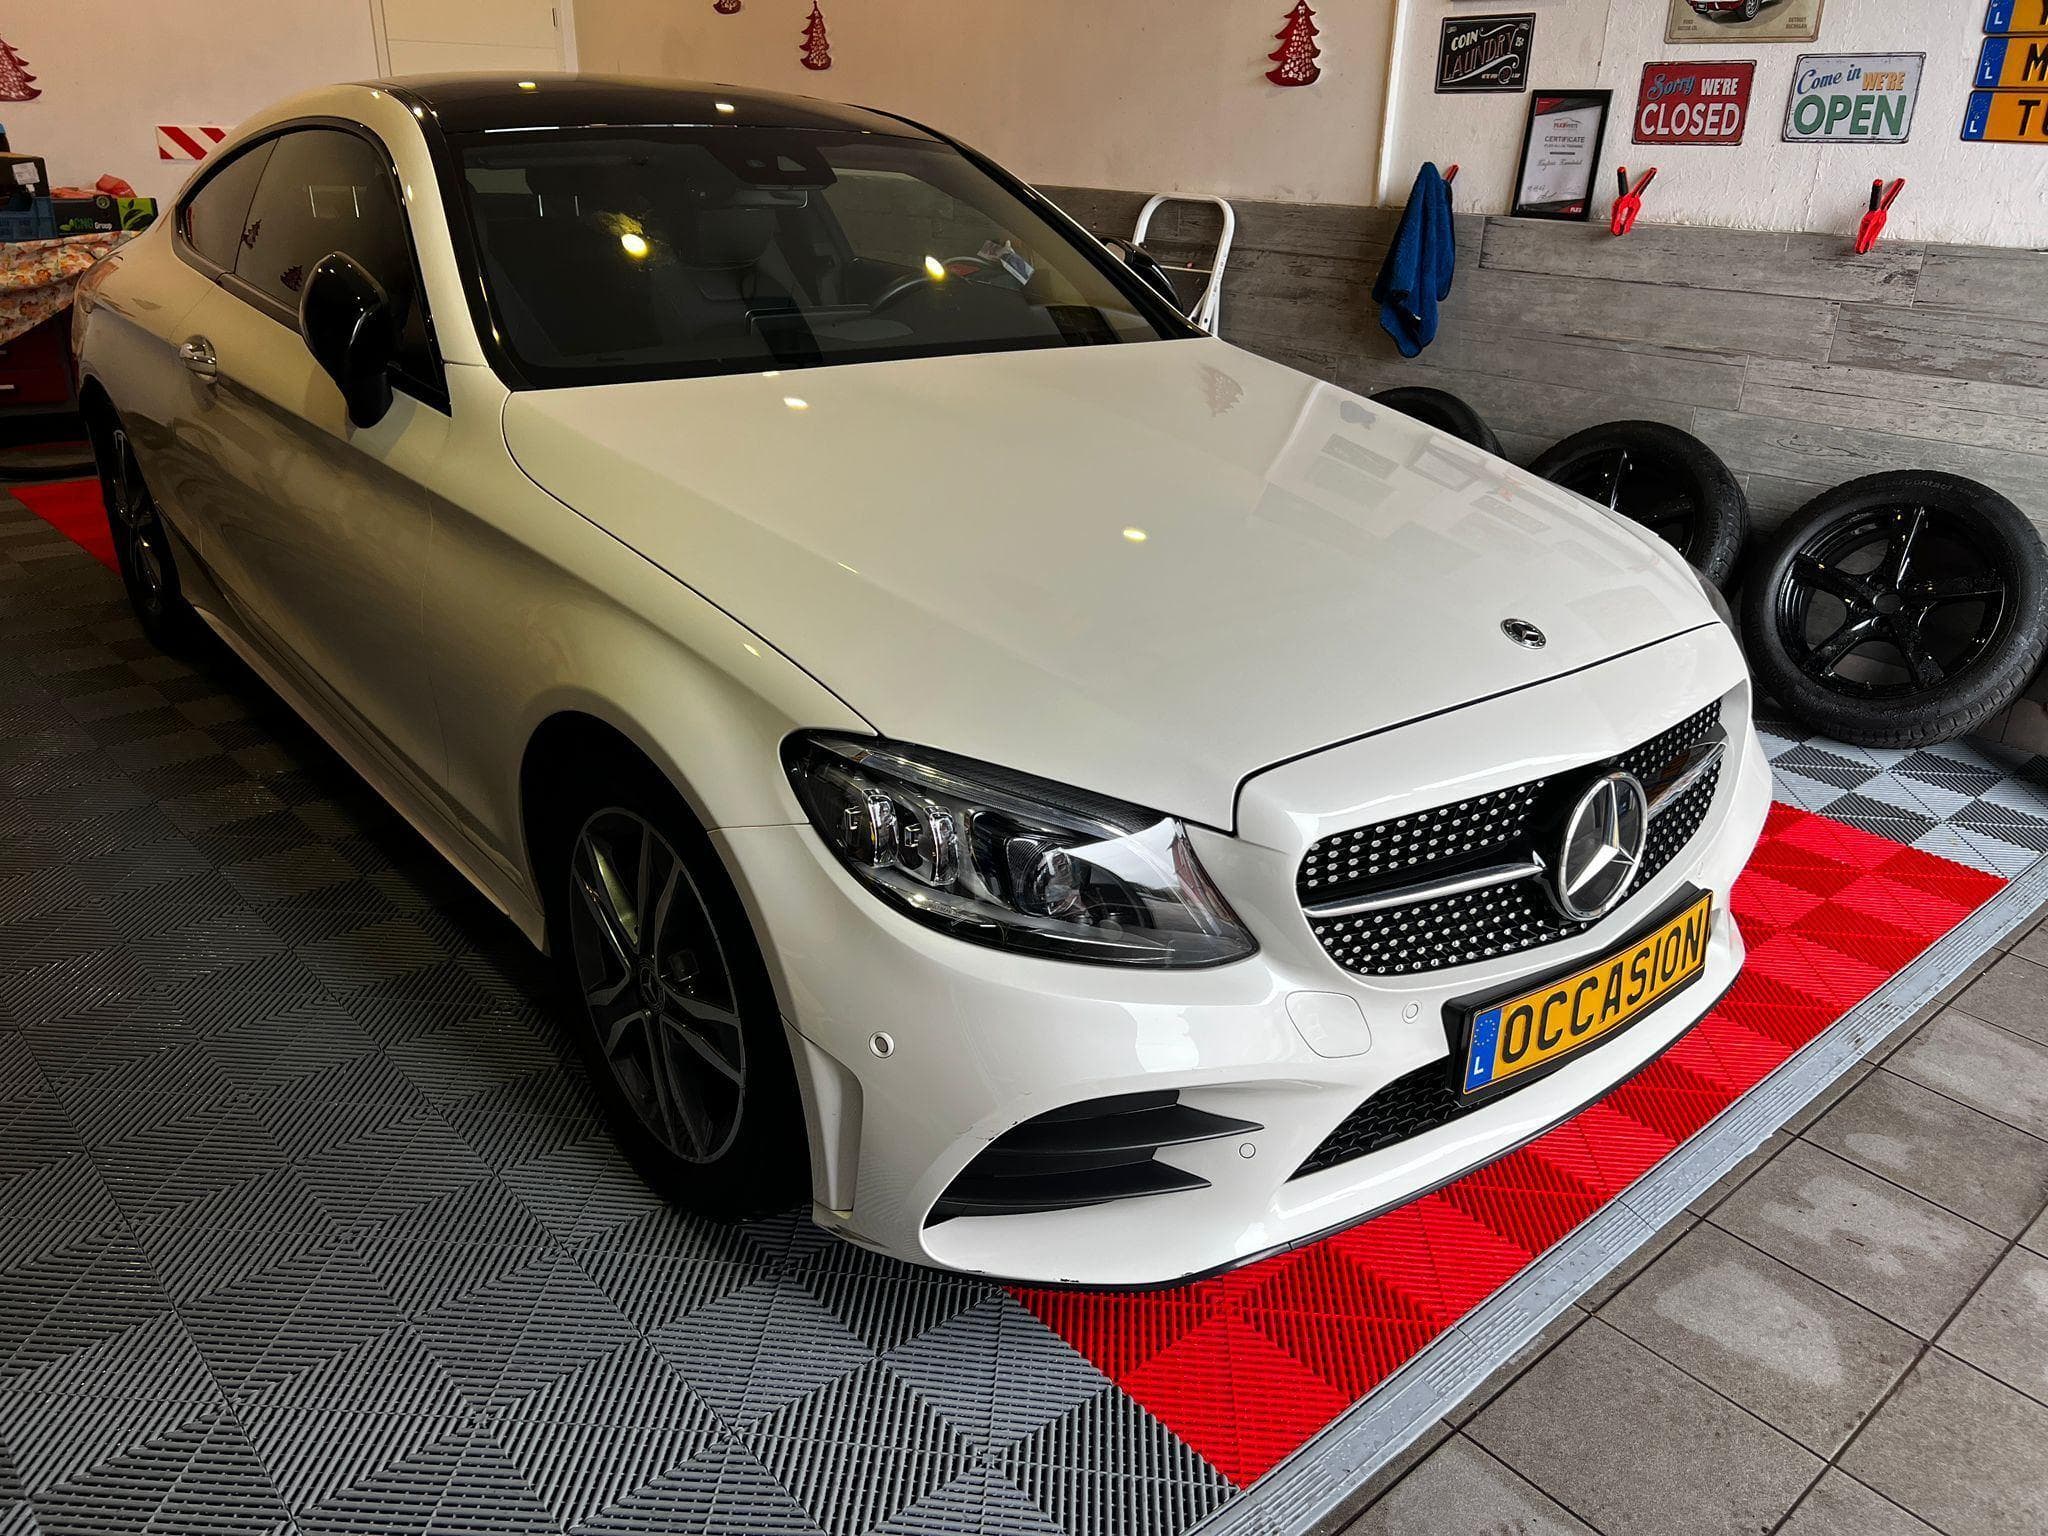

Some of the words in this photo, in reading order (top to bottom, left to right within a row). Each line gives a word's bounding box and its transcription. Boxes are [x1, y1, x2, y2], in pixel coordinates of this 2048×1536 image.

[1994, 12, 2003, 25] L
[1451, 29, 1479, 51] COIN
[1442, 27, 1520, 81] LAUNDRY
[1797, 69, 1843, 95] Come
[1846, 63, 1862, 82] in
[1862, 72, 1906, 91] WE'RE
[1984, 66, 1993, 80] L
[1647, 73, 1697, 101] Sorry
[1700, 78, 1740, 96] WE'RE
[1640, 102, 1741, 136] CLOSED
[1793, 94, 1907, 136] OPEN
[1969, 120, 1978, 133] L
[2018, 99, 2048, 136] T
[1544, 135, 1585, 143] CERTIFICATE
[95, 221, 113, 230] Group
[1501, 908, 1703, 1064] OCCASION
[1473, 1055, 1484, 1076] L
